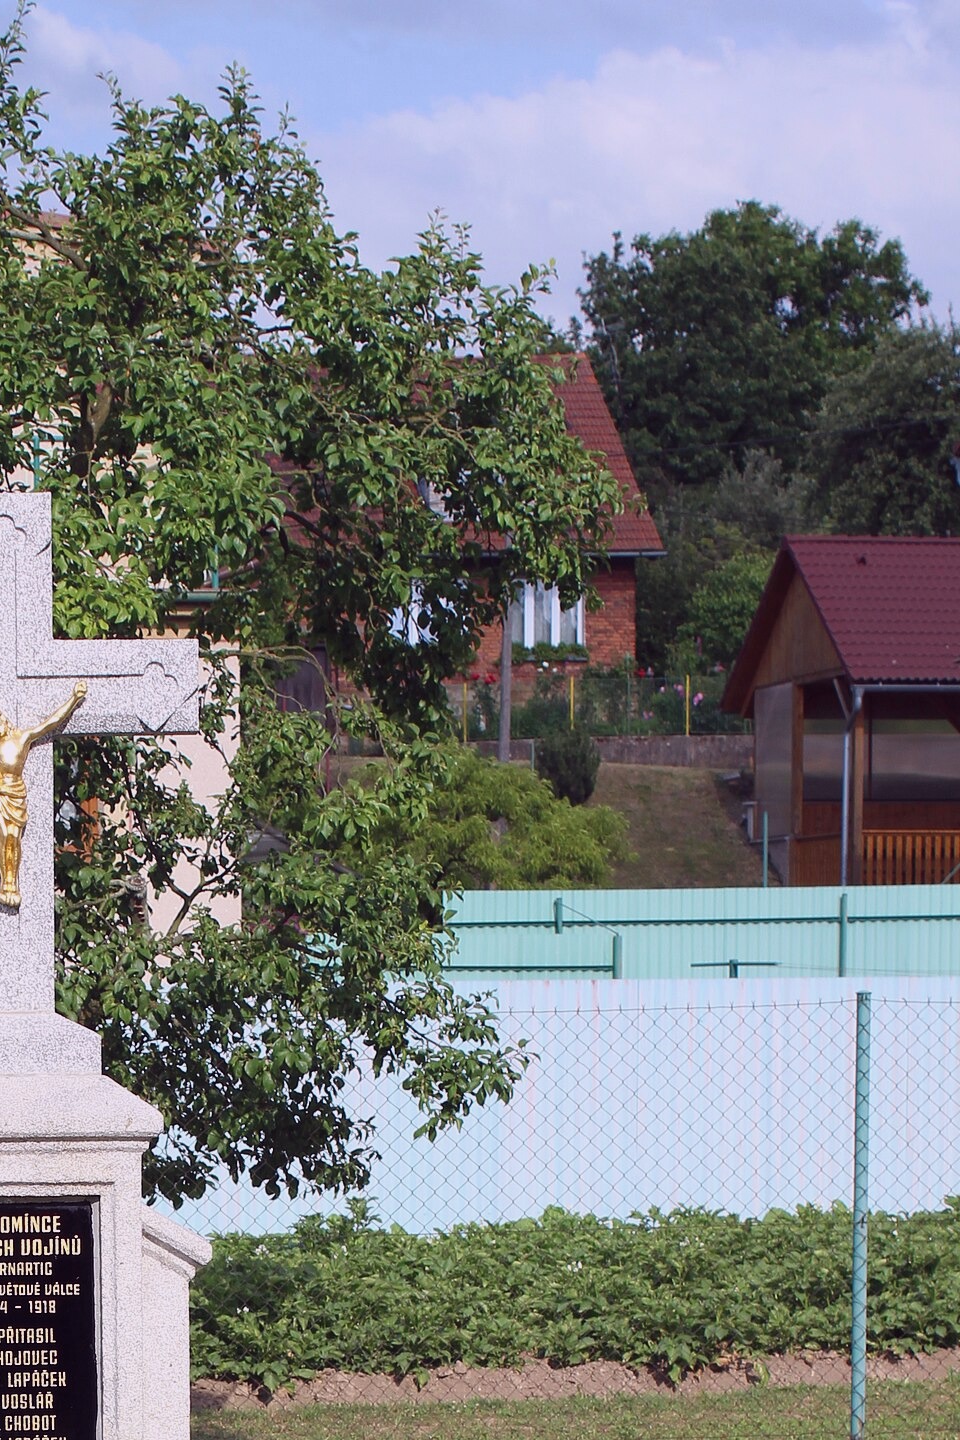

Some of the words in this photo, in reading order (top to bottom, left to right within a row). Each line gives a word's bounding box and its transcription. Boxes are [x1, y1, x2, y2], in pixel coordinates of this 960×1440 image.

[21, 1235, 80, 1257] VOJÍNŮ
[45, 1282, 80, 1295] VÁLCE
[29, 1300, 56, 1313] 1918
[8, 1370, 66, 1387] LAPÁČEK
[2, 1392, 53, 1409] VOSLÁŘ
[5, 1415, 56, 1431] CHOBOT
